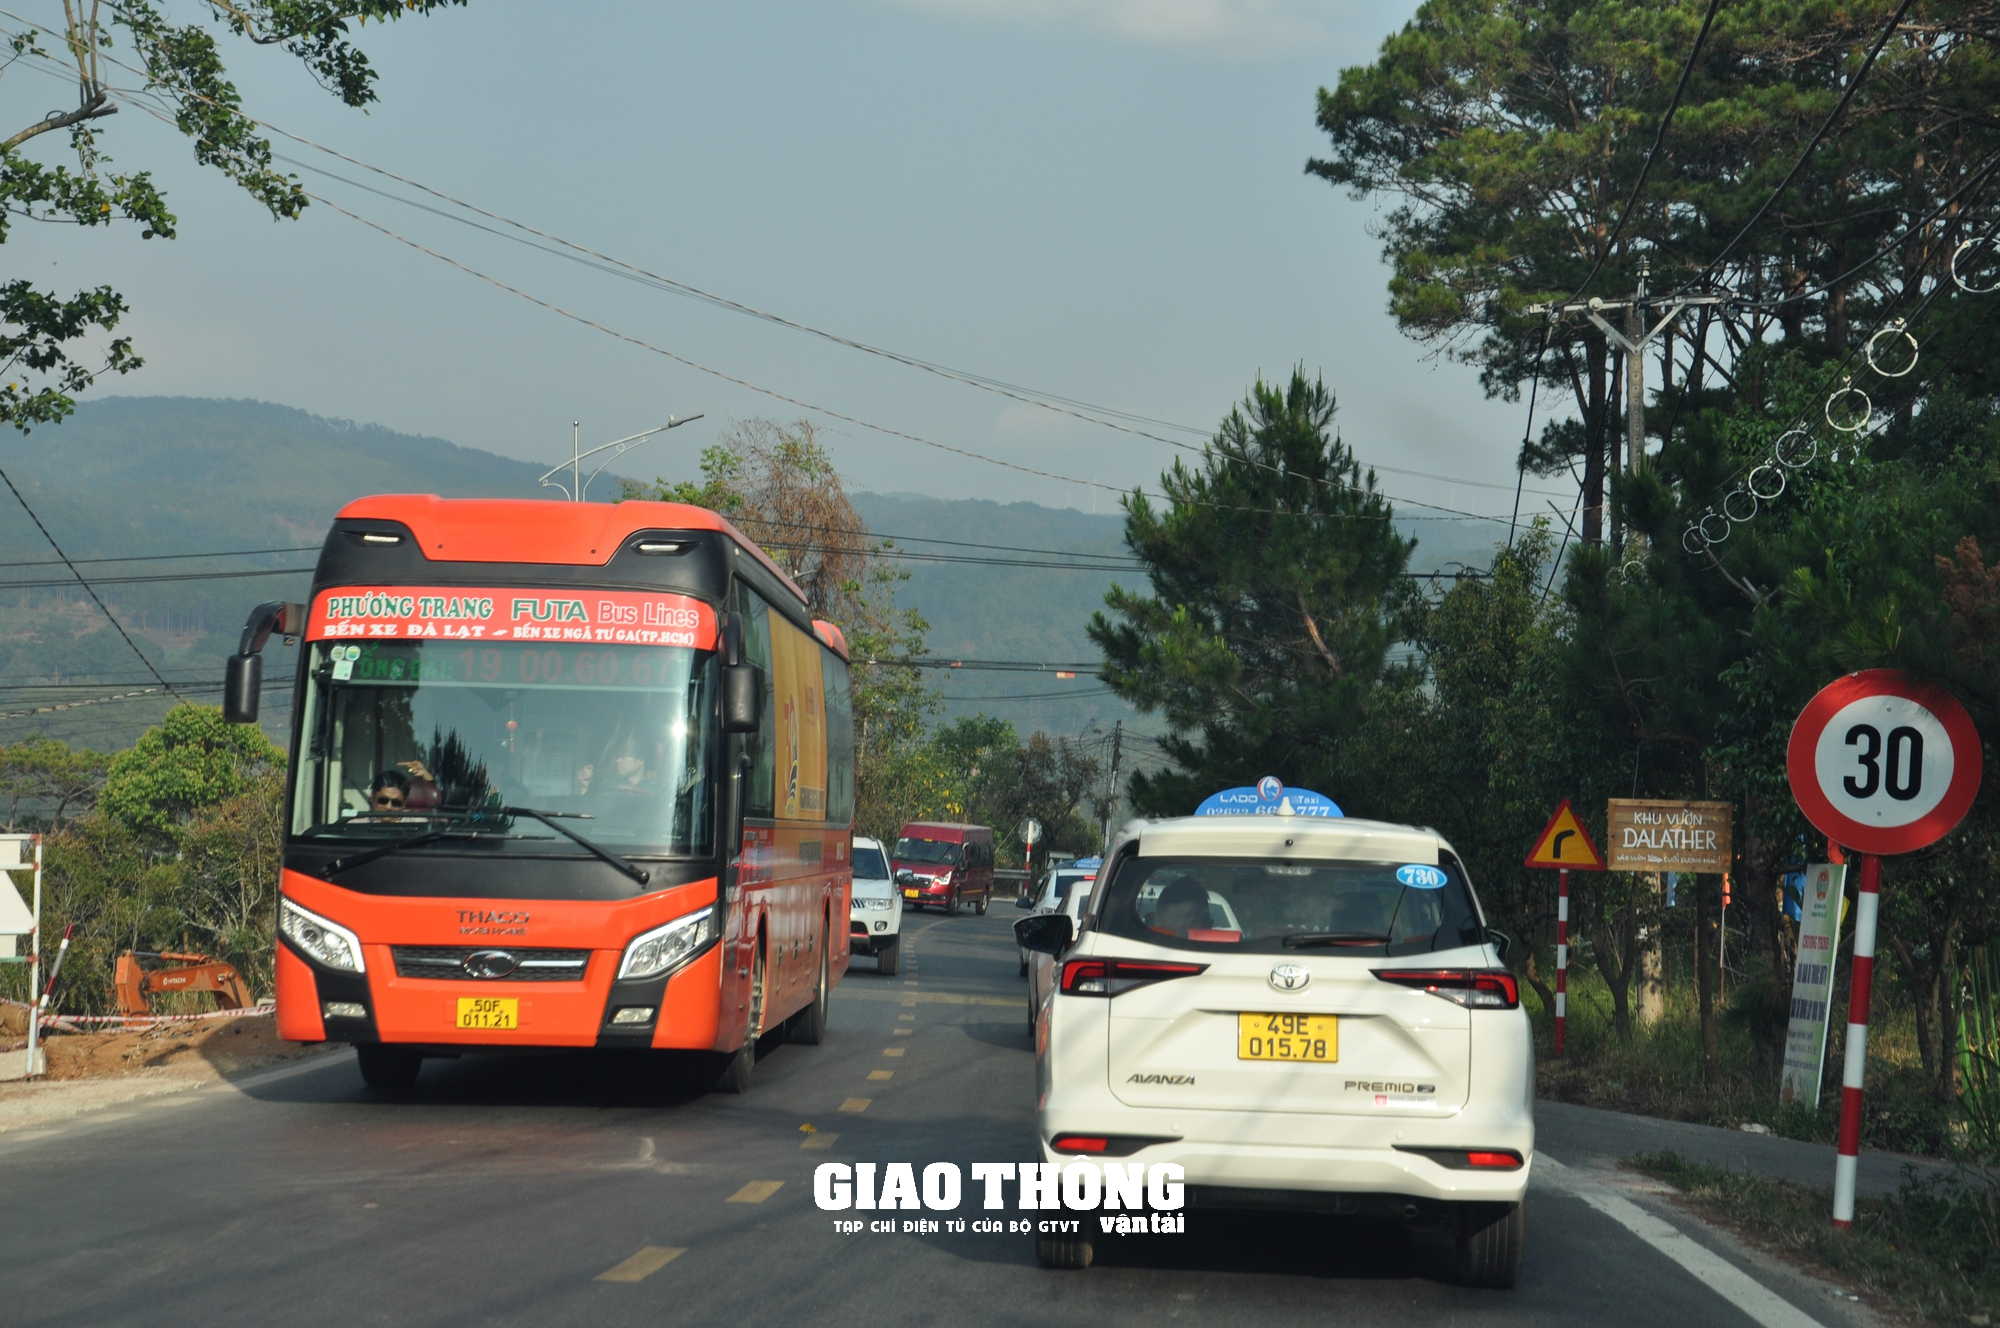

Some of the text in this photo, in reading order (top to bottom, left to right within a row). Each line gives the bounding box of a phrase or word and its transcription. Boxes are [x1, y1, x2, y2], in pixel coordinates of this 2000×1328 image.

[327, 591, 699, 628] PHƯƠNG TRANG FUTA Bus Lines
[323, 620, 365, 637] BẾN
[369, 624, 398, 636] XE
[407, 622, 438, 636] ĐÀ
[443, 625, 485, 639] LẠT
[513, 622, 540, 638] BẾN
[542, 627, 561, 639] XE
[563, 625, 592, 640] NGÃ
[595, 628, 614, 640] TƯ
[1843, 724, 1924, 801] 30
[1219, 794, 1320, 805] LADO Taxi
[1296, 806, 1330, 817] 777
[1634, 808, 1703, 826] KHU VƯỜN
[1622, 827, 1718, 850] DALATHER
[1404, 868, 1439, 886] 730
[457, 910, 530, 924] THACO
[475, 1000, 501, 1012] 50F
[463, 1013, 510, 1027] 011.21
[1267, 1014, 1309, 1035] 49E
[1250, 1037, 1327, 1059] 015.78
[1126, 1073, 1195, 1085] AVANZA
[1344, 1081, 1415, 1093] PREMIO
